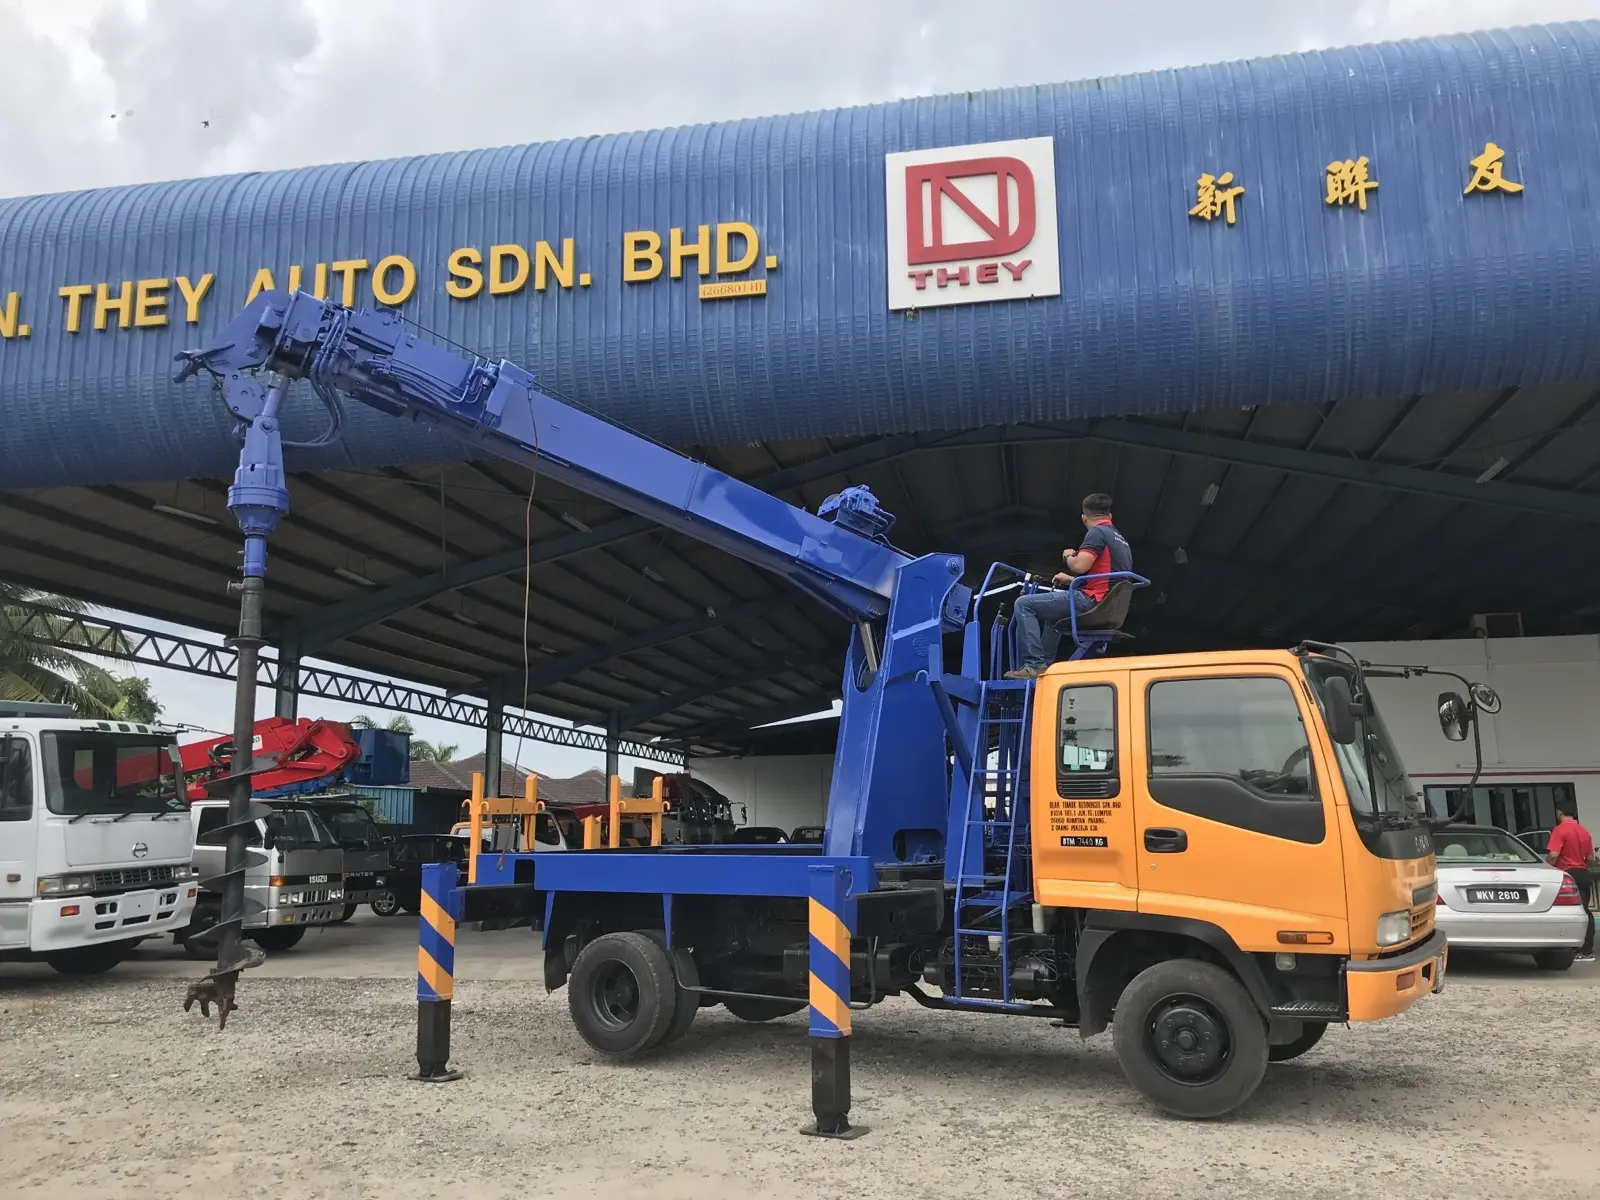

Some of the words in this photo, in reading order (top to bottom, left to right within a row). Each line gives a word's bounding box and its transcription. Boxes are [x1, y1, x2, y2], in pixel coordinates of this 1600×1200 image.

[58, 273, 216, 334] THEY
[244, 255, 417, 309] AUTO
[445, 237, 592, 300] SDN.
[623, 221, 778, 284] BHD.
[907, 260, 1033, 291] THEY
[1062, 837, 1076, 845] BTM
[1095, 838, 1104, 846] KG
[309, 874, 328, 884] ISUZU
[1475, 890, 1494, 900] WKV
[1497, 891, 1520, 900] 2610
